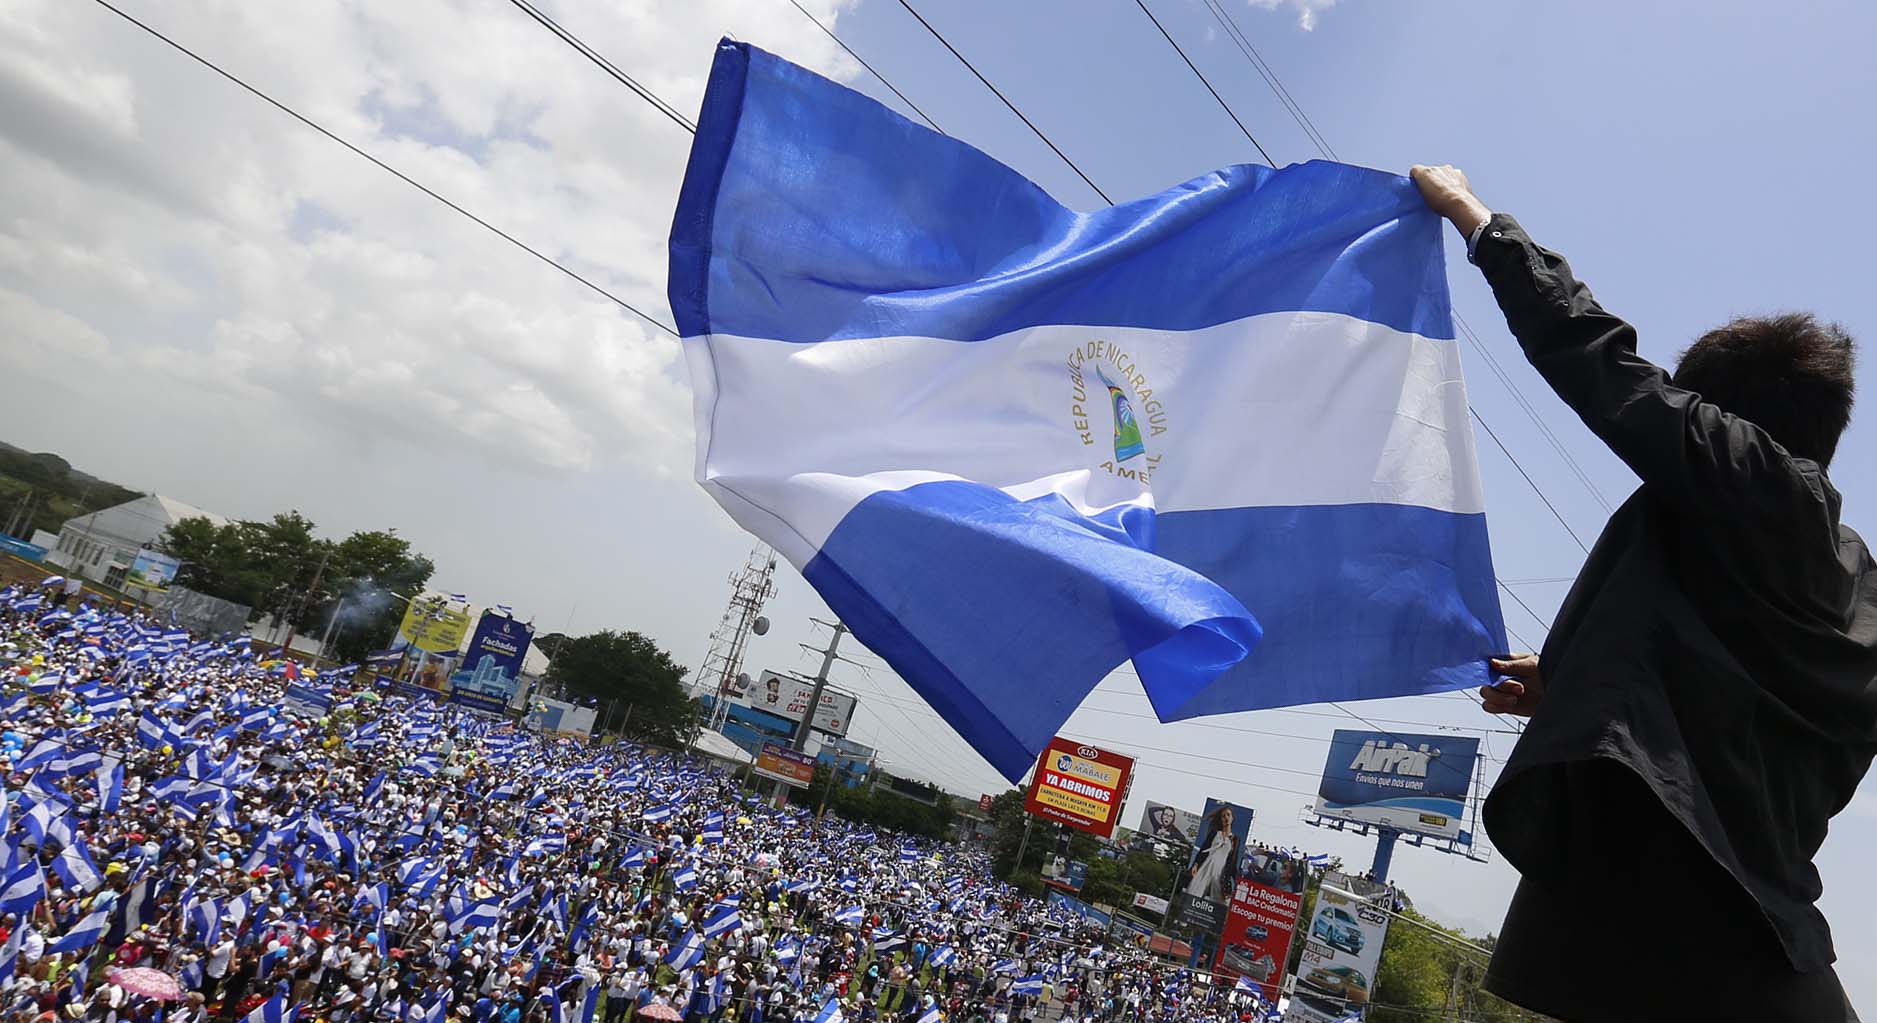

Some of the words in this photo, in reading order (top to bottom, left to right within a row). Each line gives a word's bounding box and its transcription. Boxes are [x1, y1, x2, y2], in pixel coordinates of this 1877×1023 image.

[1088, 341, 1104, 360] DE
[1105, 343, 1168, 437] NICARAGUA
[482, 636, 518, 653] Fachadas
[1081, 748, 1095, 757] KIA
[1046, 773, 1060, 786] YA
[1060, 778, 1111, 802] ABRIMOS
[1378, 777, 1392, 788] que
[1391, 777, 1405, 789] nos
[1405, 779, 1424, 790] unen
[1192, 898, 1214, 913] Lolita
[1249, 886, 1259, 897] La
[1260, 889, 1298, 909] Regalona
[1247, 897, 1260, 907] BAC
[1260, 901, 1297, 919] Credomatic
[1358, 909, 1386, 925] C30
[1257, 913, 1265, 922] tu
[1264, 916, 1294, 932] premio!
